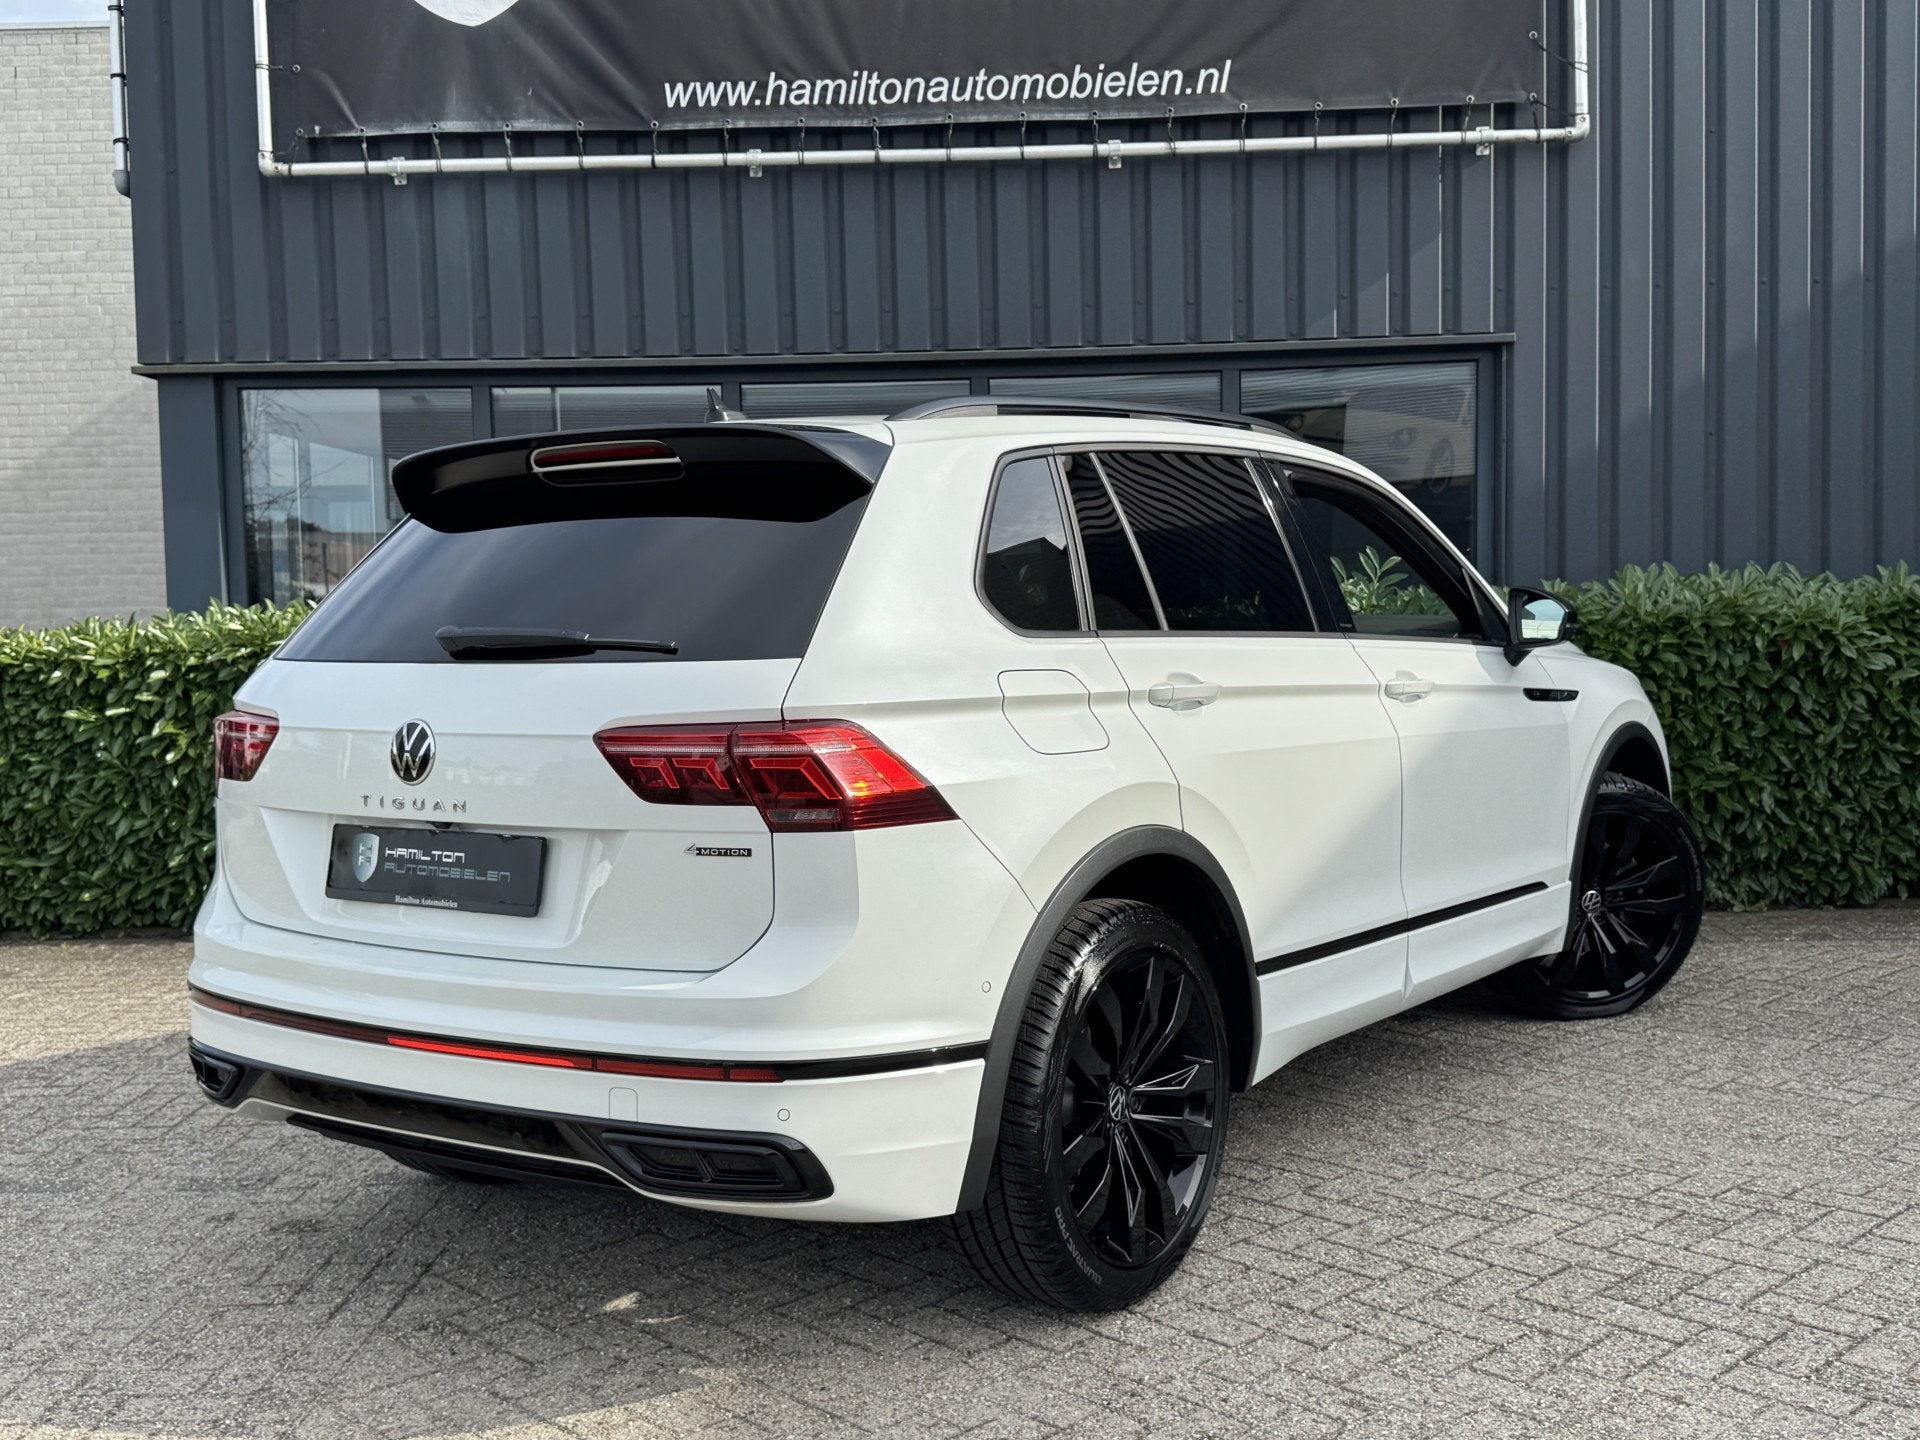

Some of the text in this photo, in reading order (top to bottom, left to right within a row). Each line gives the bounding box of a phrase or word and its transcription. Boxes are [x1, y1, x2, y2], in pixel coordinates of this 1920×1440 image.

[663, 59, 1232, 108] www.hamiltonautomobielen.nl
[360, 794, 467, 813] TIGUAN
[385, 847, 465, 863] HAMILTON
[384, 862, 511, 882] AUTOMOBIELEN
[395, 895, 458, 908] Hamilton Automobielen
[1054, 1206, 1103, 1285] QUATRAC PRO
